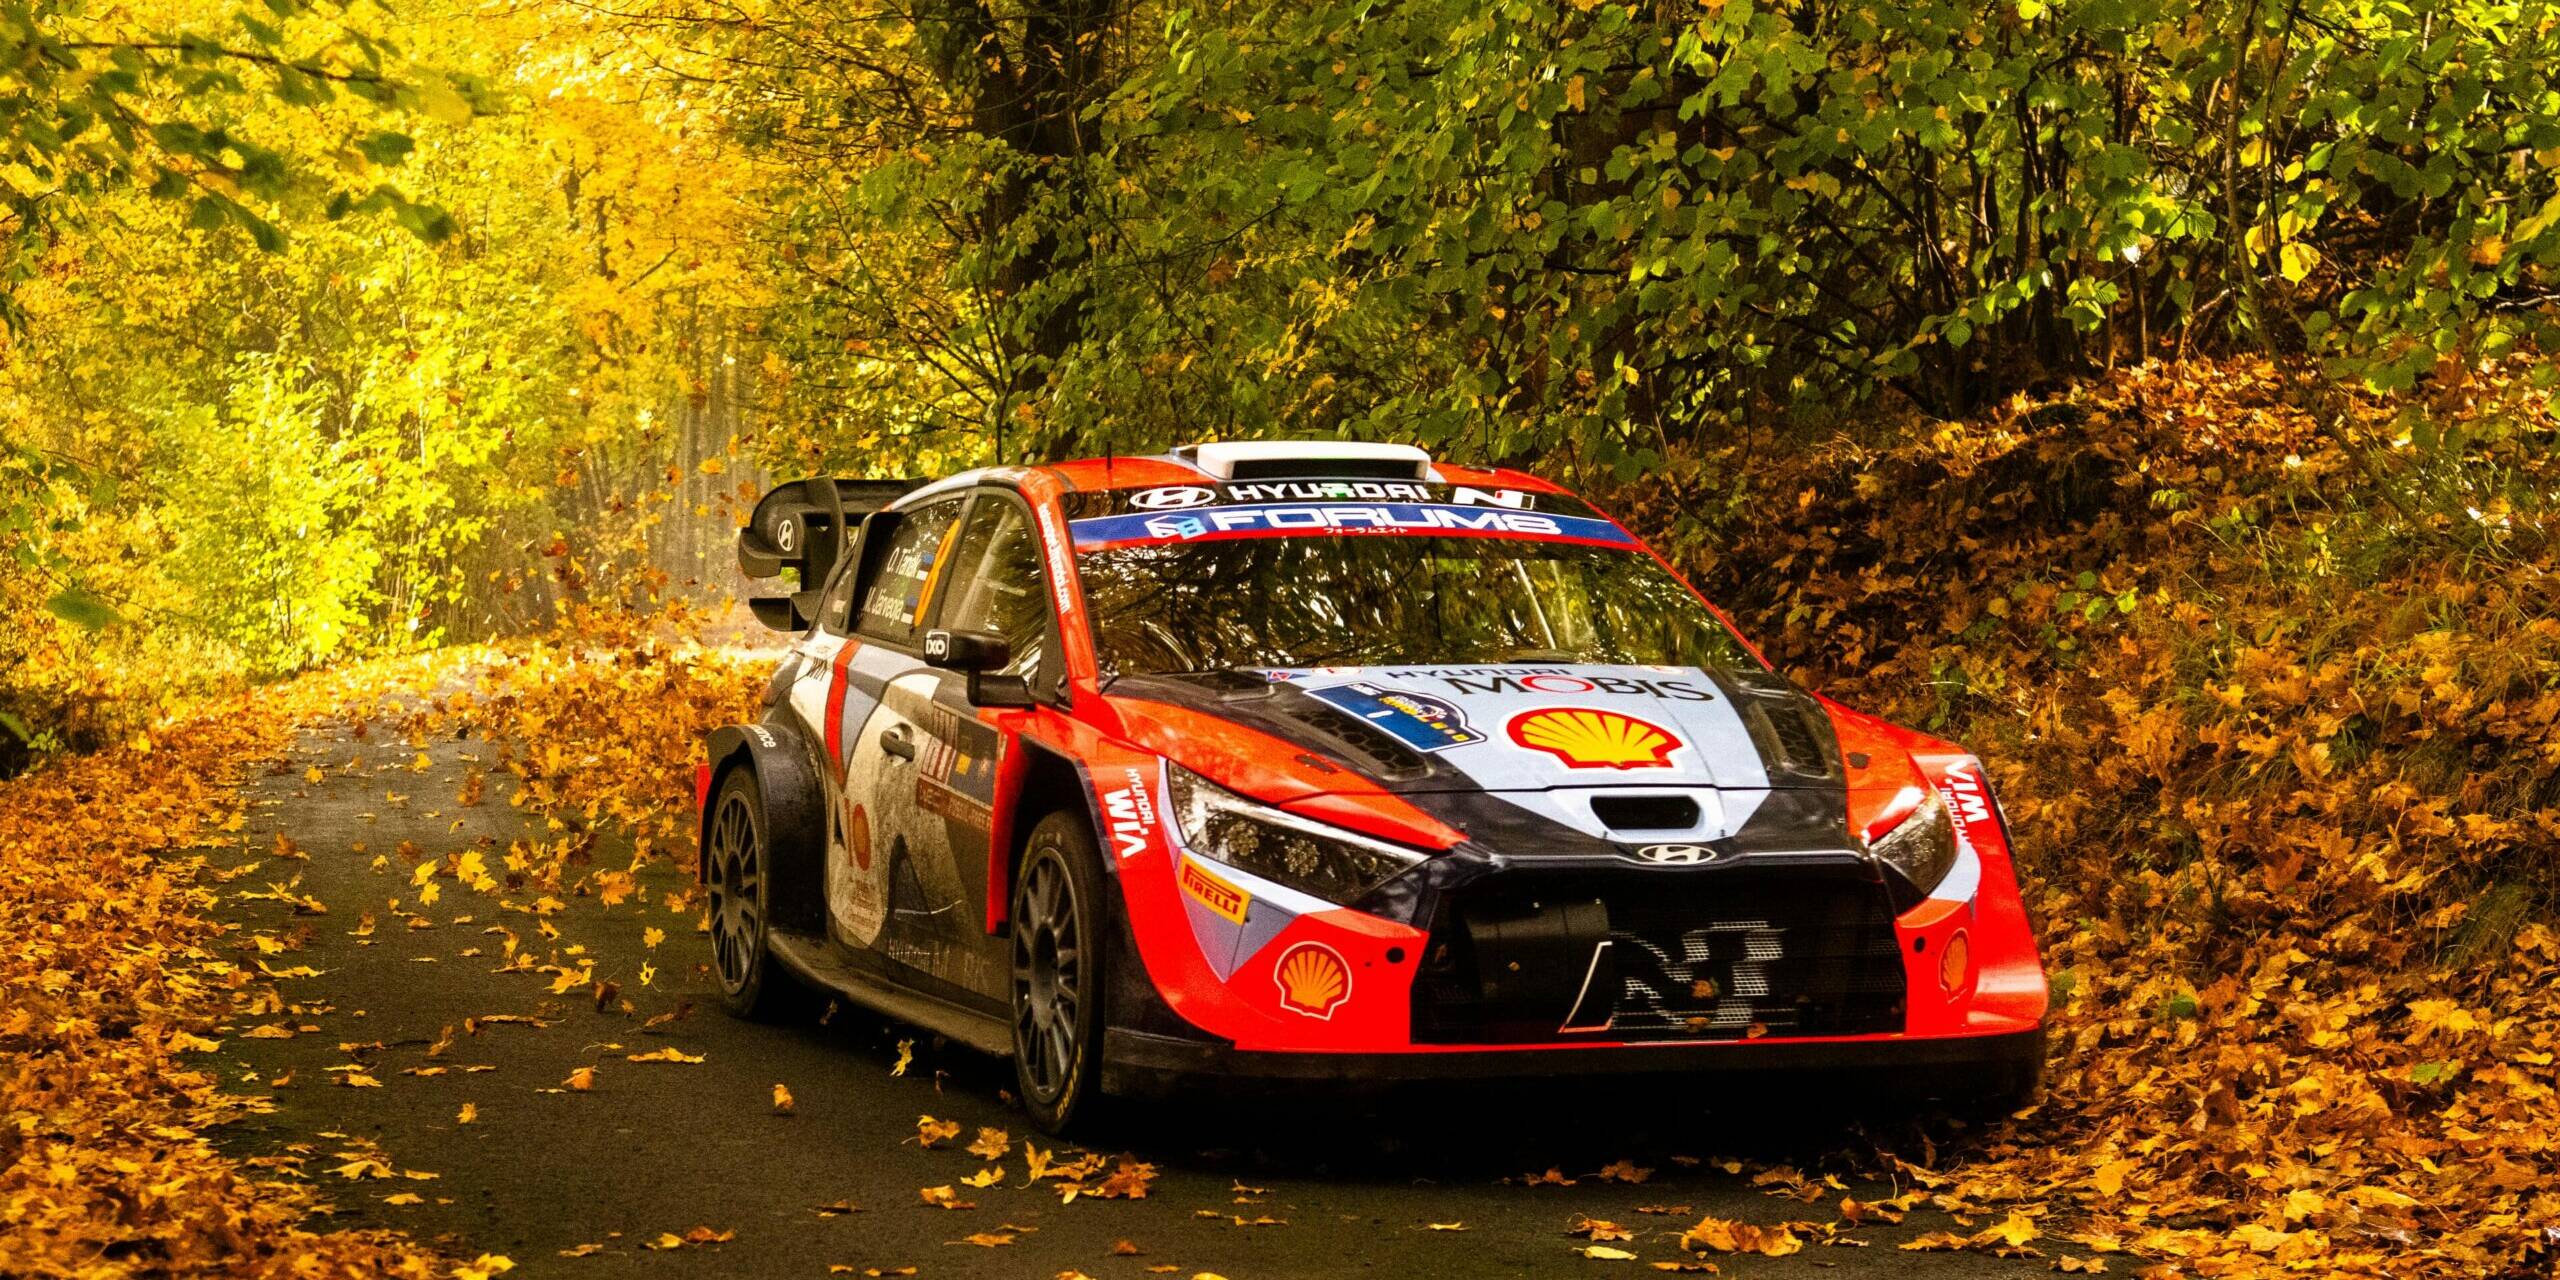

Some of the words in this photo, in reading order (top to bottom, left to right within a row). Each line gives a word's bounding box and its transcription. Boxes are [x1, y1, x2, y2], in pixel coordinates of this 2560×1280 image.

[1227, 483, 1432, 500] HYUNDAI
[1209, 508, 1562, 535] FORUM8
[1385, 668, 1572, 679] HYUNDAI
[1444, 675, 1715, 701] MOBIS
[1125, 768, 1156, 825] HYUNDAI
[1183, 864, 1242, 915] PIRELLI
